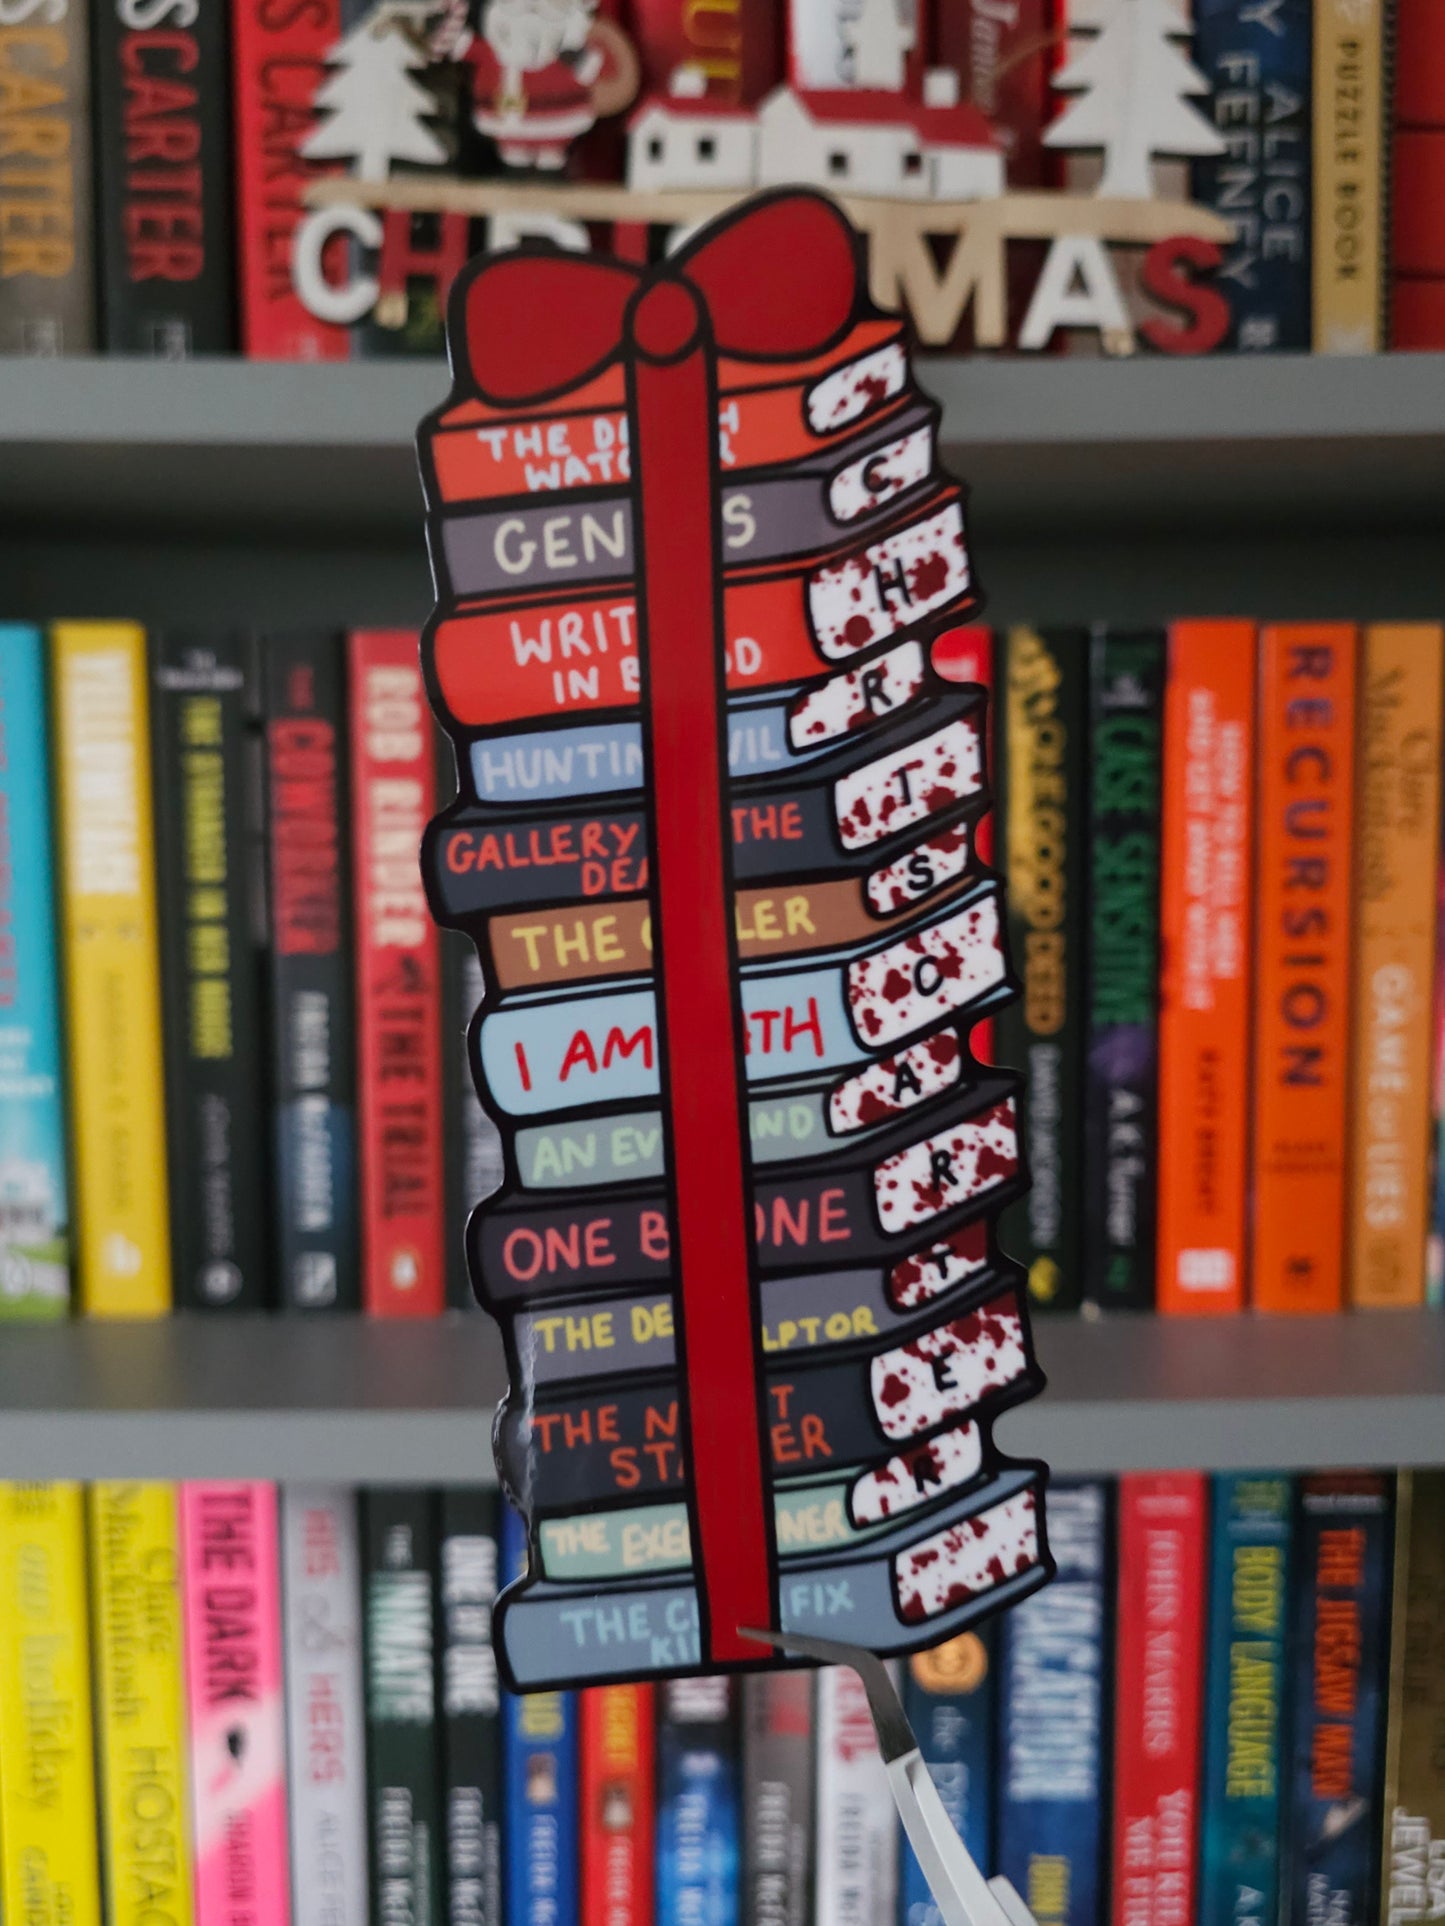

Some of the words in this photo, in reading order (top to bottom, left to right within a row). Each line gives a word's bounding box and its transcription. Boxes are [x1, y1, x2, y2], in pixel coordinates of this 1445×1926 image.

[1335, 38, 1366, 164] PUZZLE
[0, 28, 74, 279] CARTER
[120, 31, 203, 283] CARTER
[1262, 82, 1304, 262] ALICE
[1335, 181, 1365, 282] BOOK
[477, 424, 571, 462] THE
[510, 606, 636, 666] WRIT
[366, 664, 423, 761] ROB
[553, 666, 599, 704] IN
[368, 779, 426, 948] RINDER
[446, 822, 639, 875] GALLERY
[730, 801, 803, 844] THE
[1281, 645, 1334, 1088] RECURSION
[511, 915, 625, 971] THE
[1092, 832, 1155, 1027] SENSITIVE
[381, 1006, 427, 1081] THE
[513, 1042, 532, 1092] I
[559, 1025, 653, 1082] AM
[1370, 963, 1416, 1093] GAME
[382, 1103, 428, 1221] TRIAL
[531, 1132, 597, 1182] AN
[1366, 1142, 1408, 1229] LIES
[503, 1218, 616, 1281] ONE
[534, 1312, 616, 1352] THE
[528, 1405, 621, 1453] THE
[203, 1490, 255, 1571] THE
[305, 1509, 340, 1578] HIS
[443, 1536, 498, 1599] ONE
[545, 1520, 611, 1558] THE
[1316, 1528, 1367, 1588] THE
[1144, 1530, 1178, 1624] JOHN
[1232, 1546, 1284, 1630] BODY
[203, 1585, 260, 1706] DARK
[369, 1570, 432, 1726] INMATE
[561, 1603, 652, 1647] THE
[1312, 1597, 1361, 1718] JIGSAW
[18, 1634, 76, 1811] holiday
[443, 1643, 500, 1717] ONE
[1009, 1581, 1100, 1798] VACATION
[1143, 1630, 1178, 1759] MARRS
[1226, 1641, 1281, 1797] LANGUAGE
[307, 1672, 345, 1784] HERS
[1309, 1724, 1354, 1798] MAN
[378, 1786, 413, 1875] FREIDA
[448, 1786, 484, 1875] FREIDA
[756, 1781, 791, 1865] FREIDA
[840, 1792, 865, 1871] FREIDA
[1389, 1806, 1430, 1926] JEWEL
